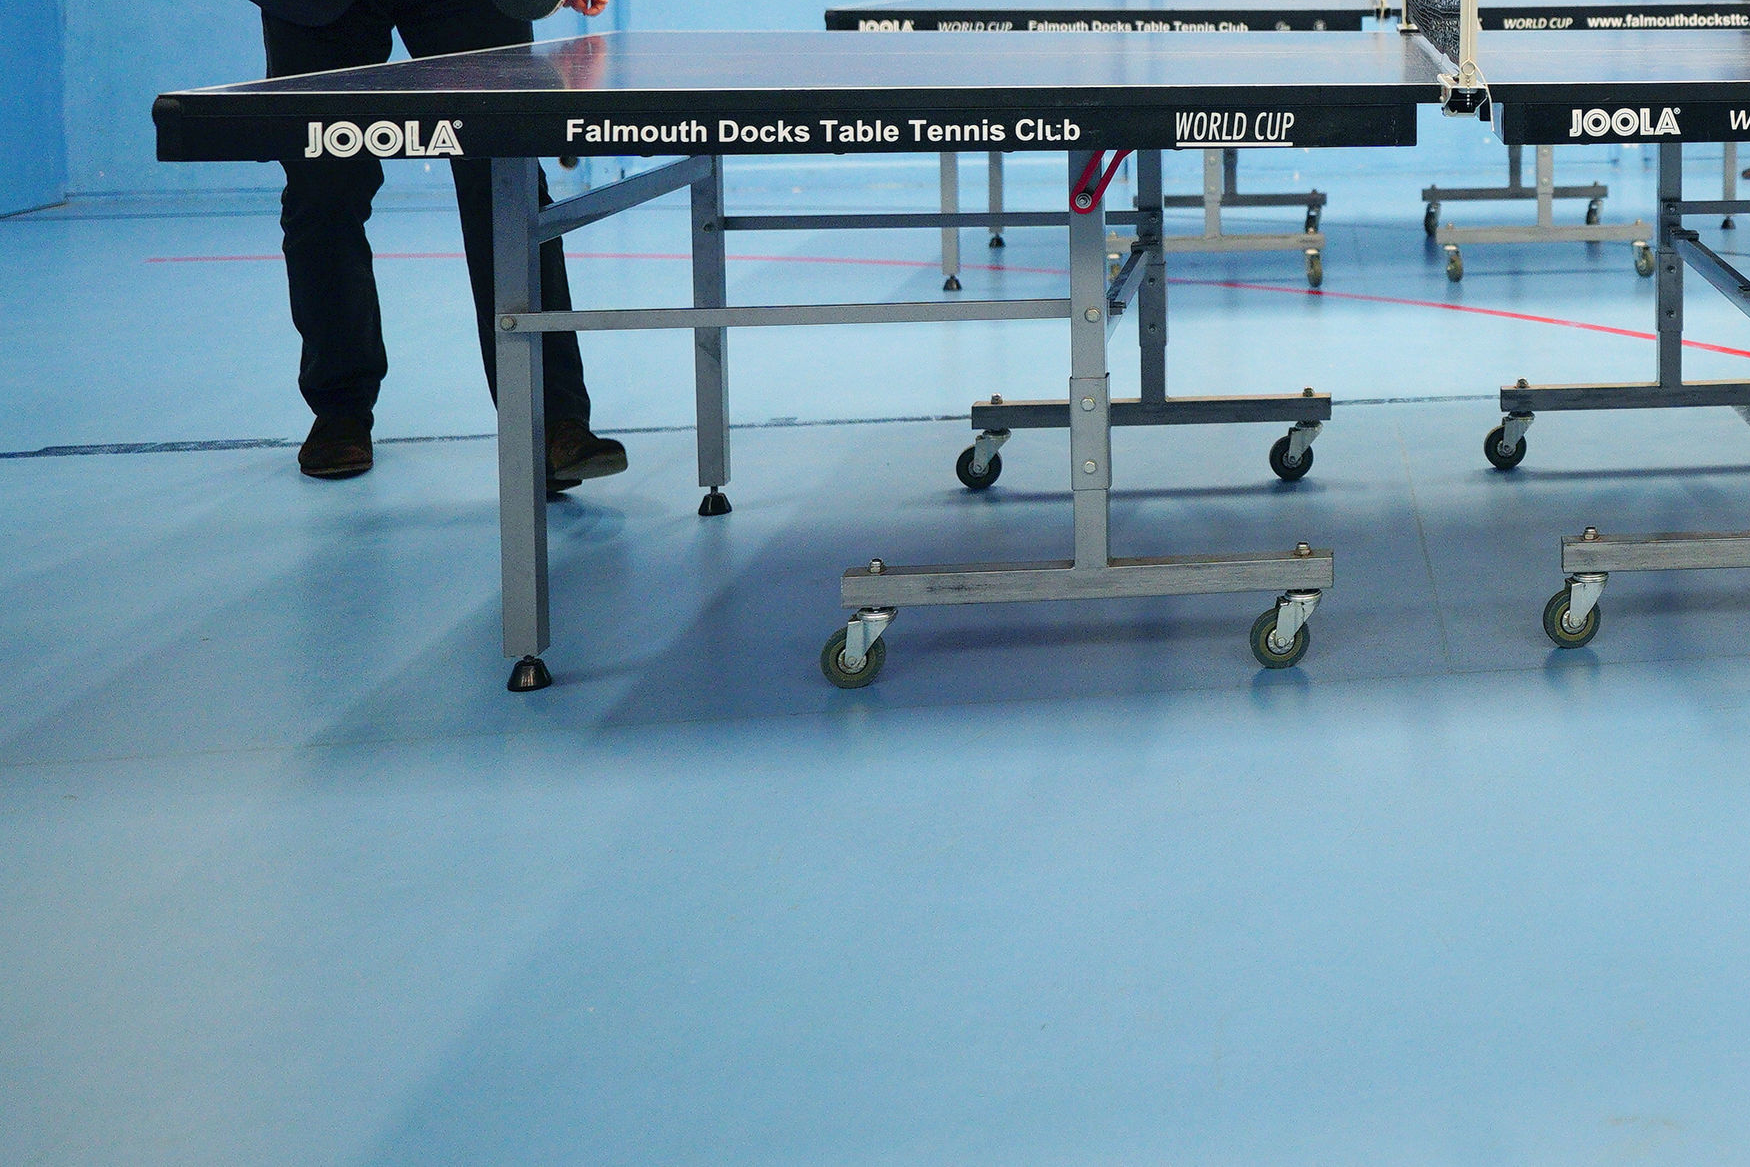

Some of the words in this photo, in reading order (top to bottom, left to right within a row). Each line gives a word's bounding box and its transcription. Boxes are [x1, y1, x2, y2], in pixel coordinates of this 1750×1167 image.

[1028, 20, 1089, 32] Falmouth
[1092, 20, 1132, 32] Docks
[1135, 20, 1171, 32] Table
[1173, 21, 1215, 32] Tennis
[1218, 21, 1249, 32] Club
[1503, 18, 1548, 30] WORLD
[1549, 17, 1574, 29] CUP
[566, 119, 708, 143] Falmouth
[718, 119, 811, 143] Docks
[819, 119, 900, 143] Table
[908, 118, 1006, 142] Tennis
[1015, 118, 1081, 142] Club
[1175, 112, 1247, 142] WORLD
[1254, 112, 1295, 141] CUP
